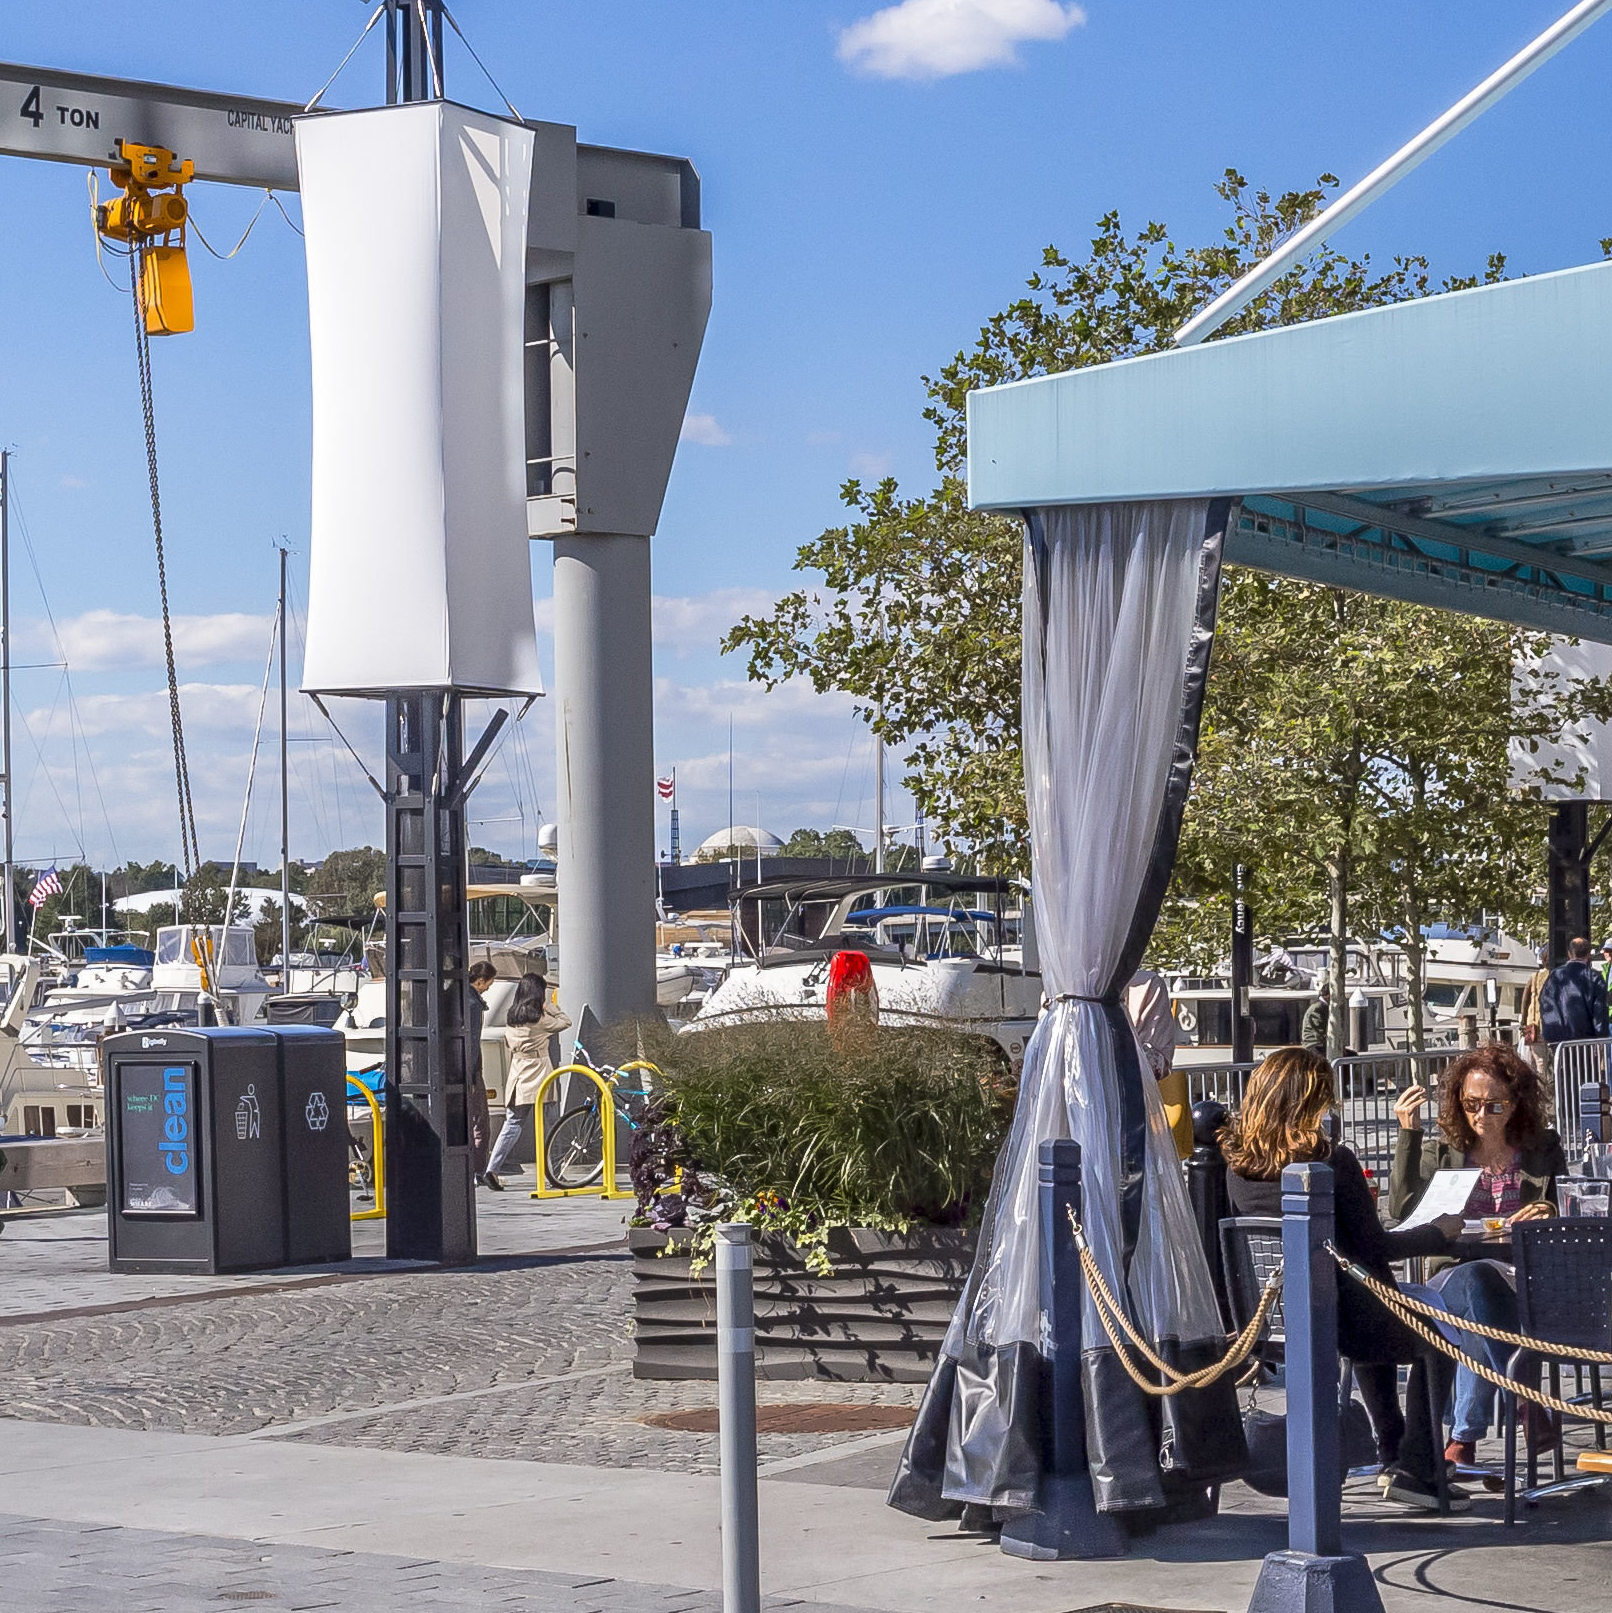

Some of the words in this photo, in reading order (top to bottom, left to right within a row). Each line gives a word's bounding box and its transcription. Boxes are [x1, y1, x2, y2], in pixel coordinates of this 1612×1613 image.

[19, 85, 44, 128] 4
[56, 105, 100, 130] TON
[227, 109, 269, 132] CAPITAL
[1235, 864, 1245, 934] Emegency
[158, 1067, 187, 1175] clean
